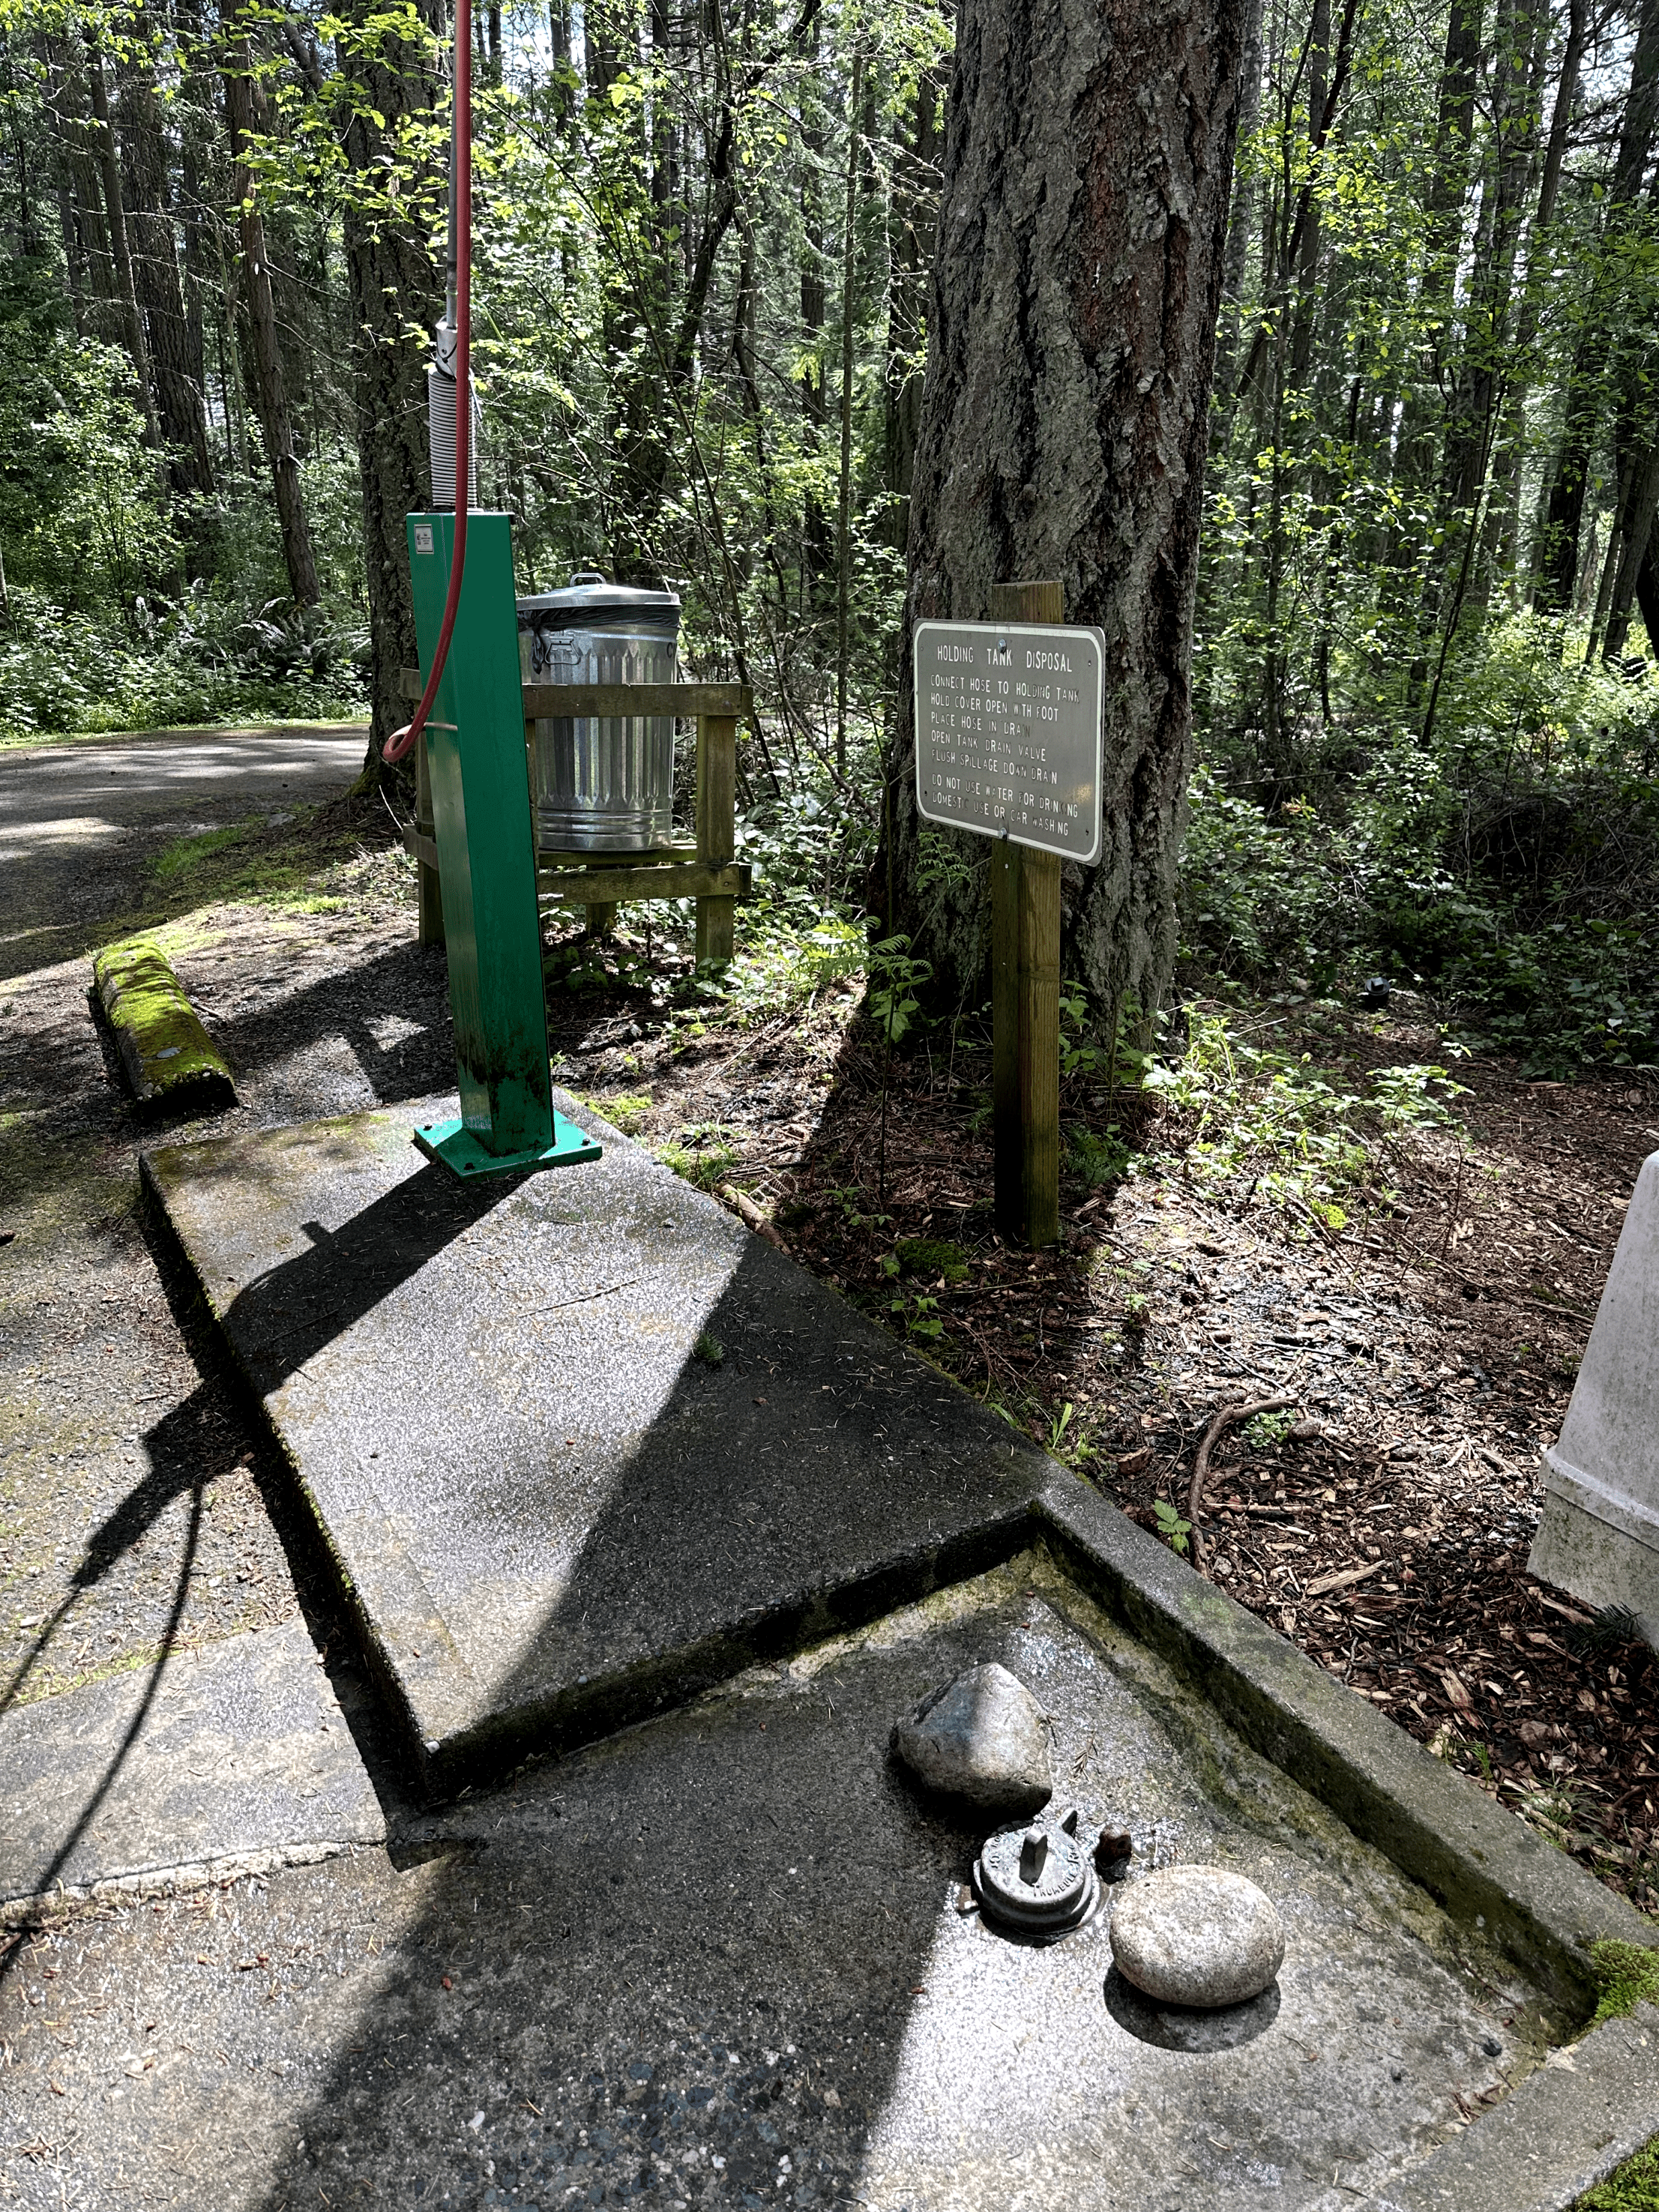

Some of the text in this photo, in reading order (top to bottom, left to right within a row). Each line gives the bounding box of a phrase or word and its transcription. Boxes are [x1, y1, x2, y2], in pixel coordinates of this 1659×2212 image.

[937, 645, 1072, 672] HOLDING TANK DISPOSAL
[930, 675, 1080, 703] CONNECT HOSE TO HOLDING TANK
[930, 692, 1059, 722] HOLD COVER OPEN WITH FOOT
[931, 711, 1030, 738] PLACE HOSE IN DRAIN
[931, 729, 1046, 762] OPEN TANK DRAIN VALVE
[932, 749, 1058, 785] FLUSH SPILLAGE DOWN DRAIN
[932, 774, 1078, 818] DO NOT USE WATER FOR DRINKING
[933, 792, 1068, 837] DOMESTIC USE OR CAR WASHING
